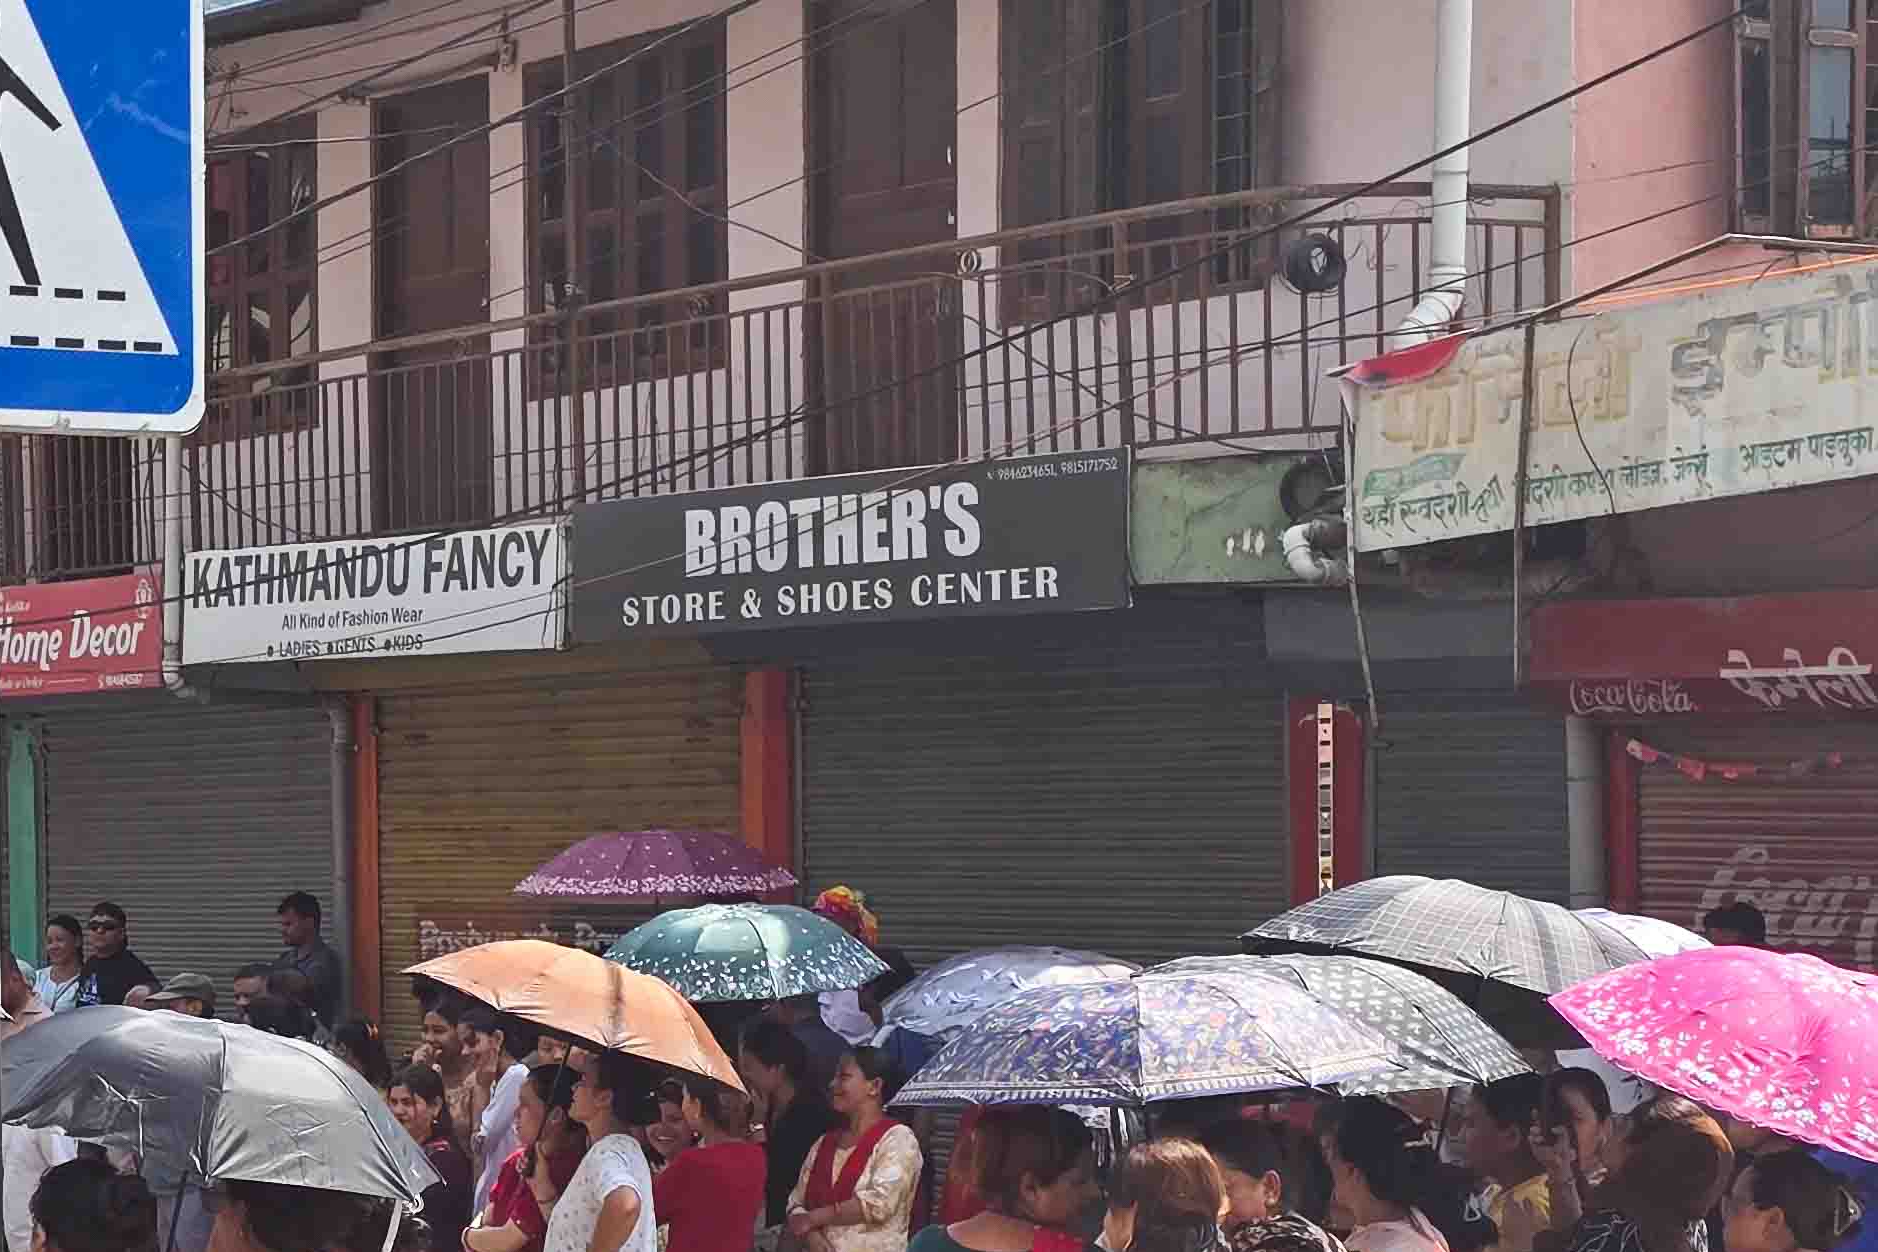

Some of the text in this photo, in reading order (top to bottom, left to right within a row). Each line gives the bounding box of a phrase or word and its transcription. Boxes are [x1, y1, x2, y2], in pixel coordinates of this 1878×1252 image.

[684, 480, 981, 577] BROTHER'S
[191, 527, 552, 609] KATHMANDU FANCY
[282, 607, 424, 631] All Kind of Fashion Wear
[623, 566, 1059, 627] STORE & SHOES CENTER
[69, 609, 146, 658] Decor
[279, 639, 320, 657] LADIES
[393, 633, 424, 650] KIDS
